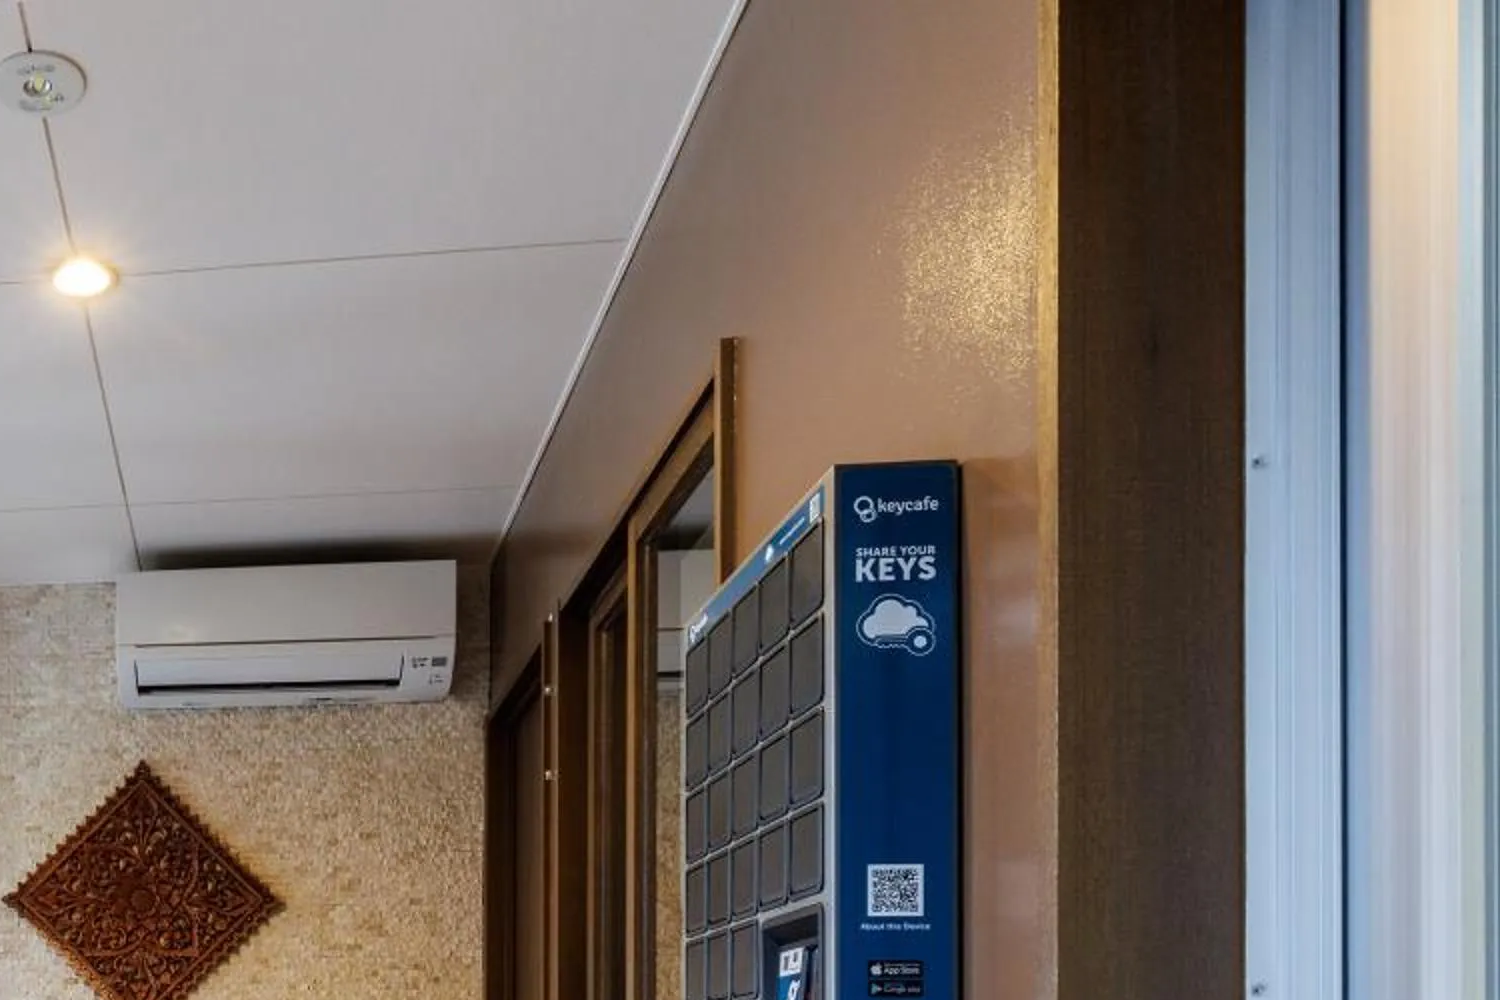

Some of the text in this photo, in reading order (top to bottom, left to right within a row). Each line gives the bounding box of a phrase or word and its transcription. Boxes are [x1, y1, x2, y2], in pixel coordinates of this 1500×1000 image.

[877, 496, 939, 516] keycafe
[856, 545, 937, 556] SHARE YOUR
[855, 556, 937, 583] KEYS
